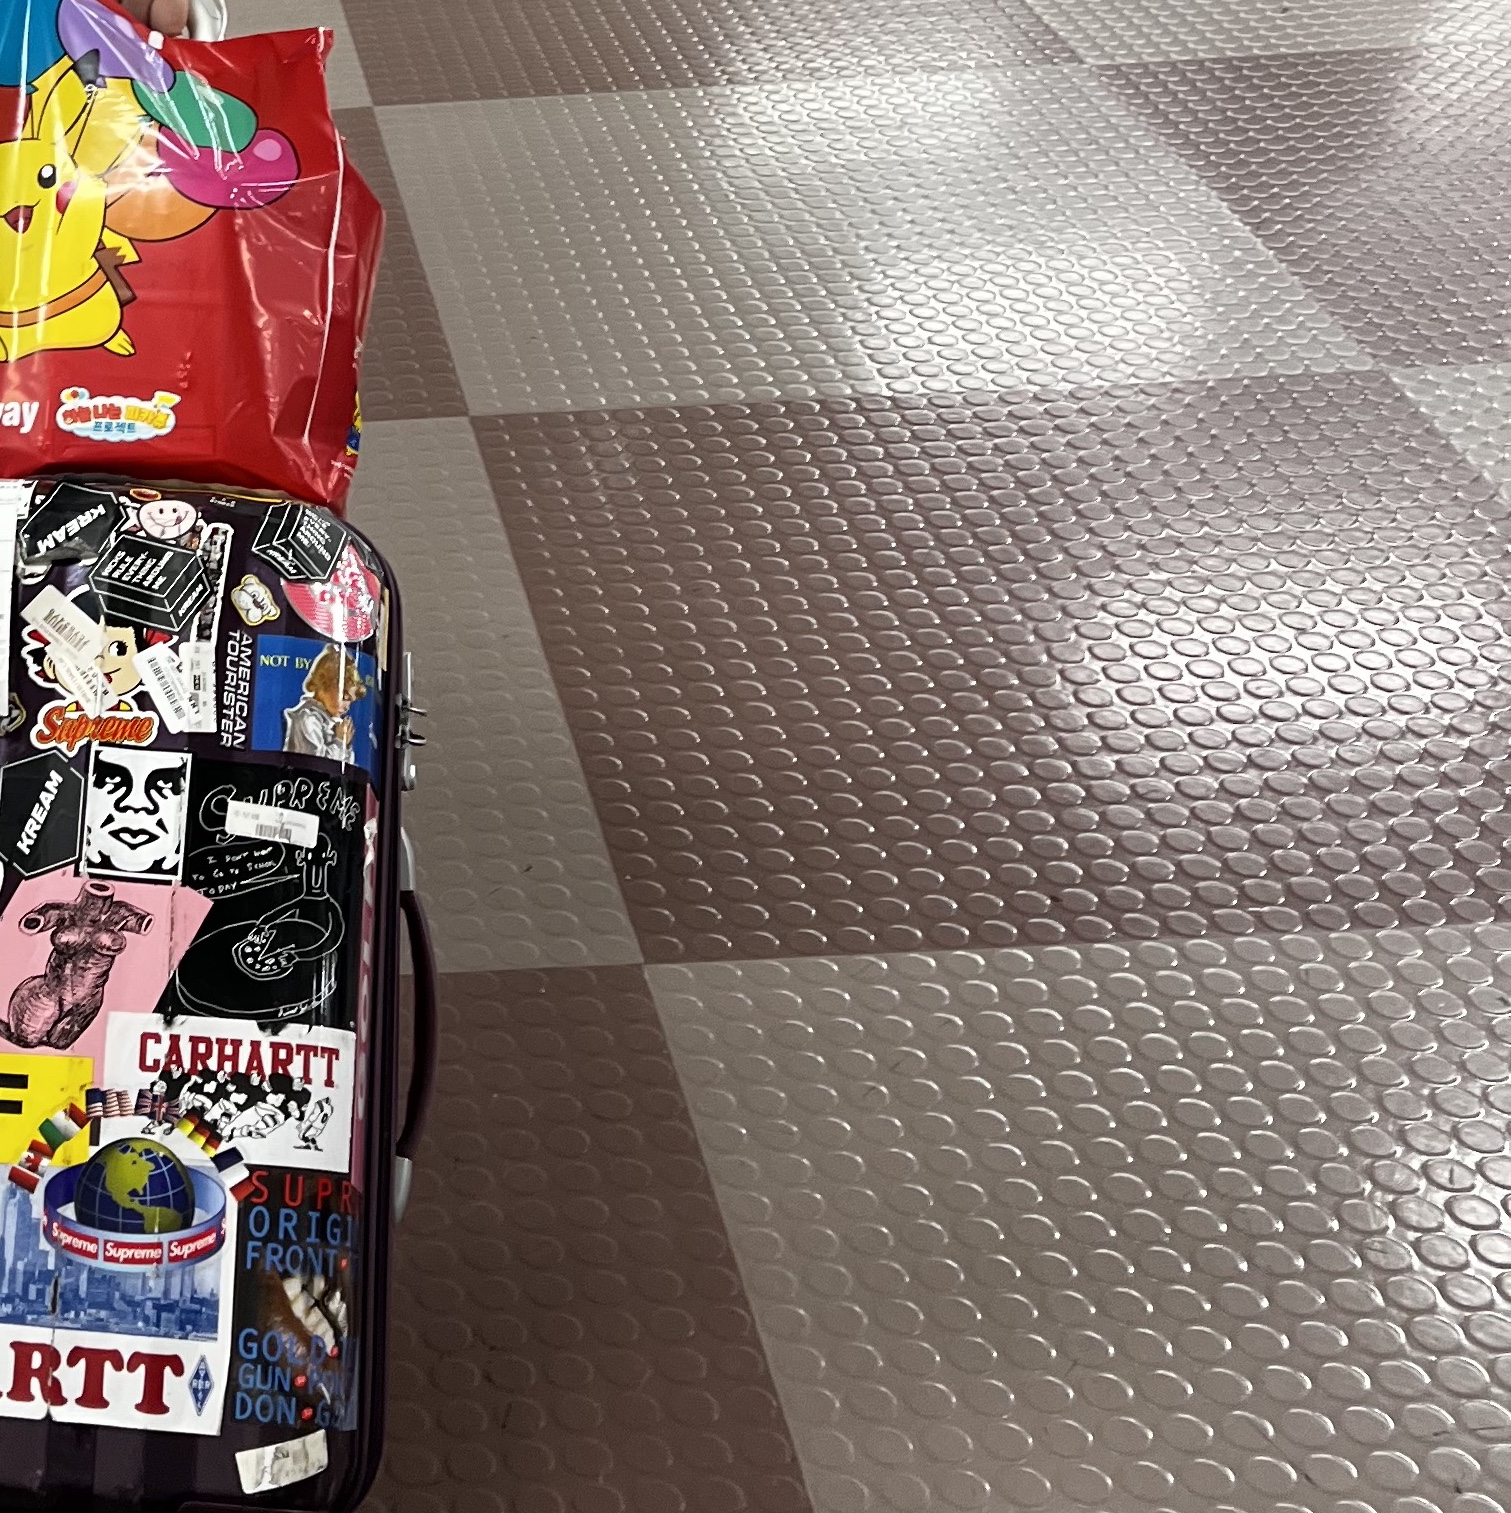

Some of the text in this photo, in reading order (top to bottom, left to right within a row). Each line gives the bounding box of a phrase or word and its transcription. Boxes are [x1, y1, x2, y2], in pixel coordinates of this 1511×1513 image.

[259, 654, 291, 668] NOT
[219, 629, 240, 748] TOURISTER
[233, 630, 253, 750] AMERICAN
[35, 706, 155, 752] Supreme
[16, 769, 65, 856] KREAM
[138, 1031, 340, 1088] CARHARTT
[104, 1242, 163, 1264] Supreme
[168, 1231, 217, 1258] Supreme
[238, 1363, 292, 1392] GUN
[234, 1390, 297, 1425] DON
